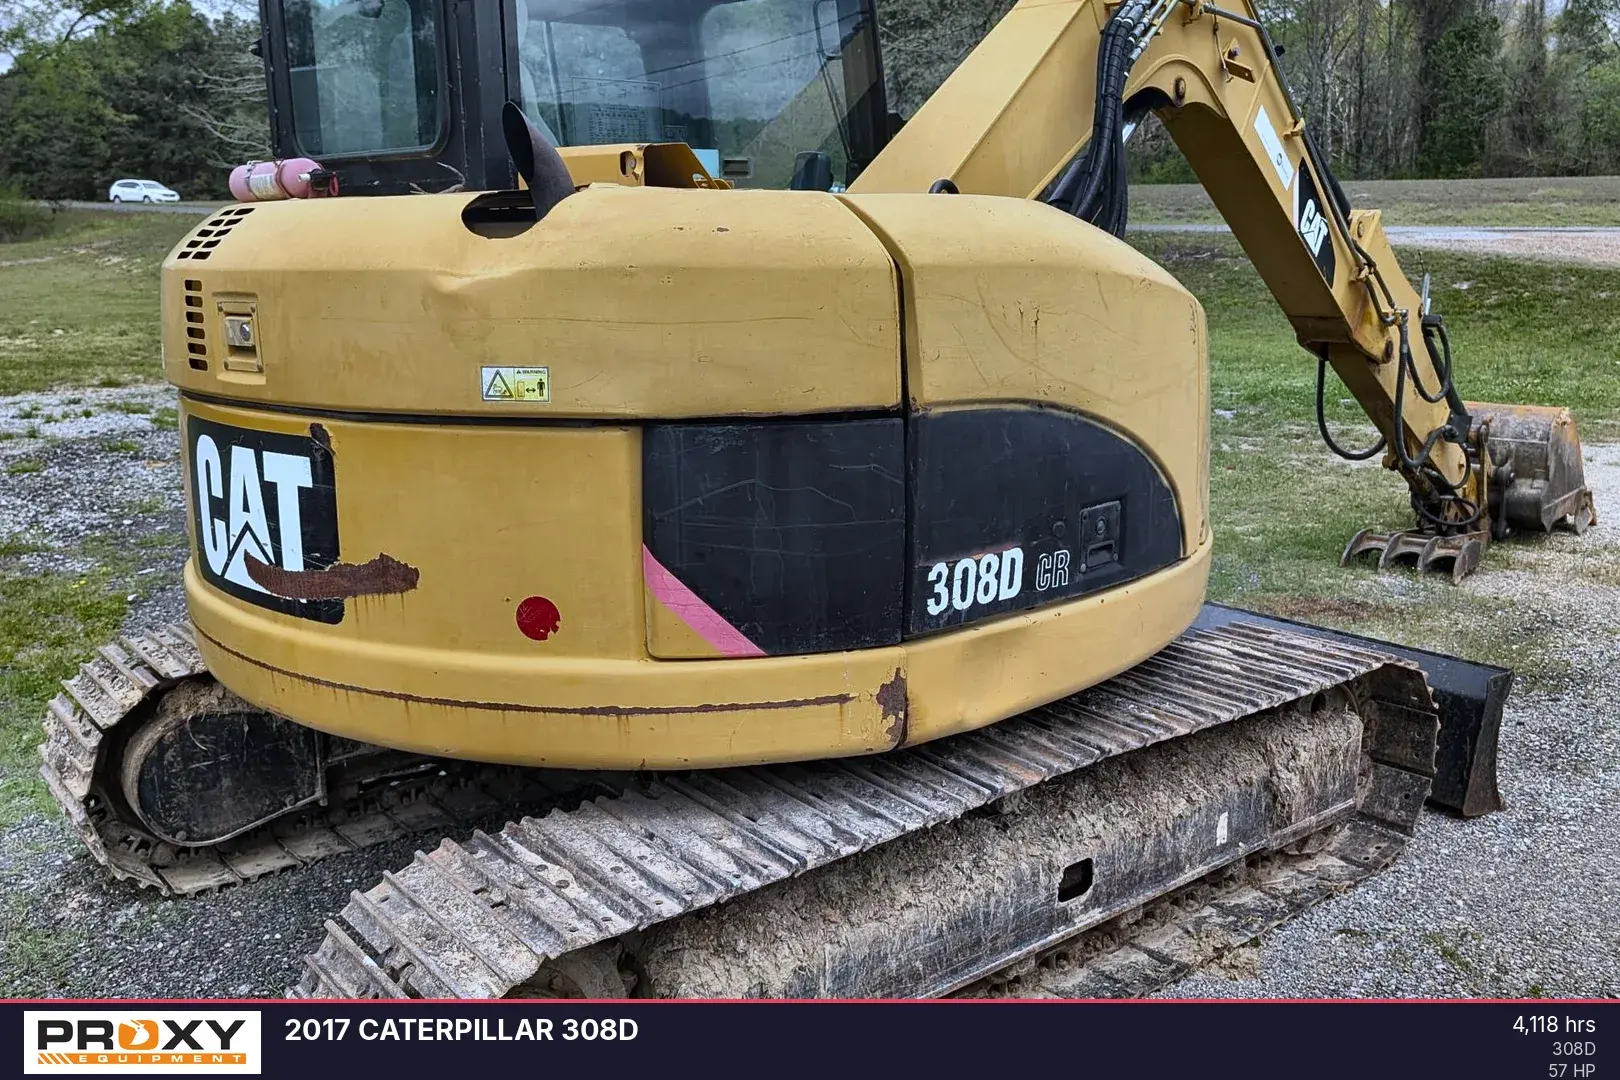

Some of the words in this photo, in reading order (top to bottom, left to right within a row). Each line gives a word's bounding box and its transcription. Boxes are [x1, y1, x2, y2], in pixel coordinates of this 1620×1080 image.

[1300, 198, 1328, 257] CAT
[196, 434, 313, 602] CAT
[926, 547, 1024, 616] 308D
[1035, 549, 1071, 592] CR
